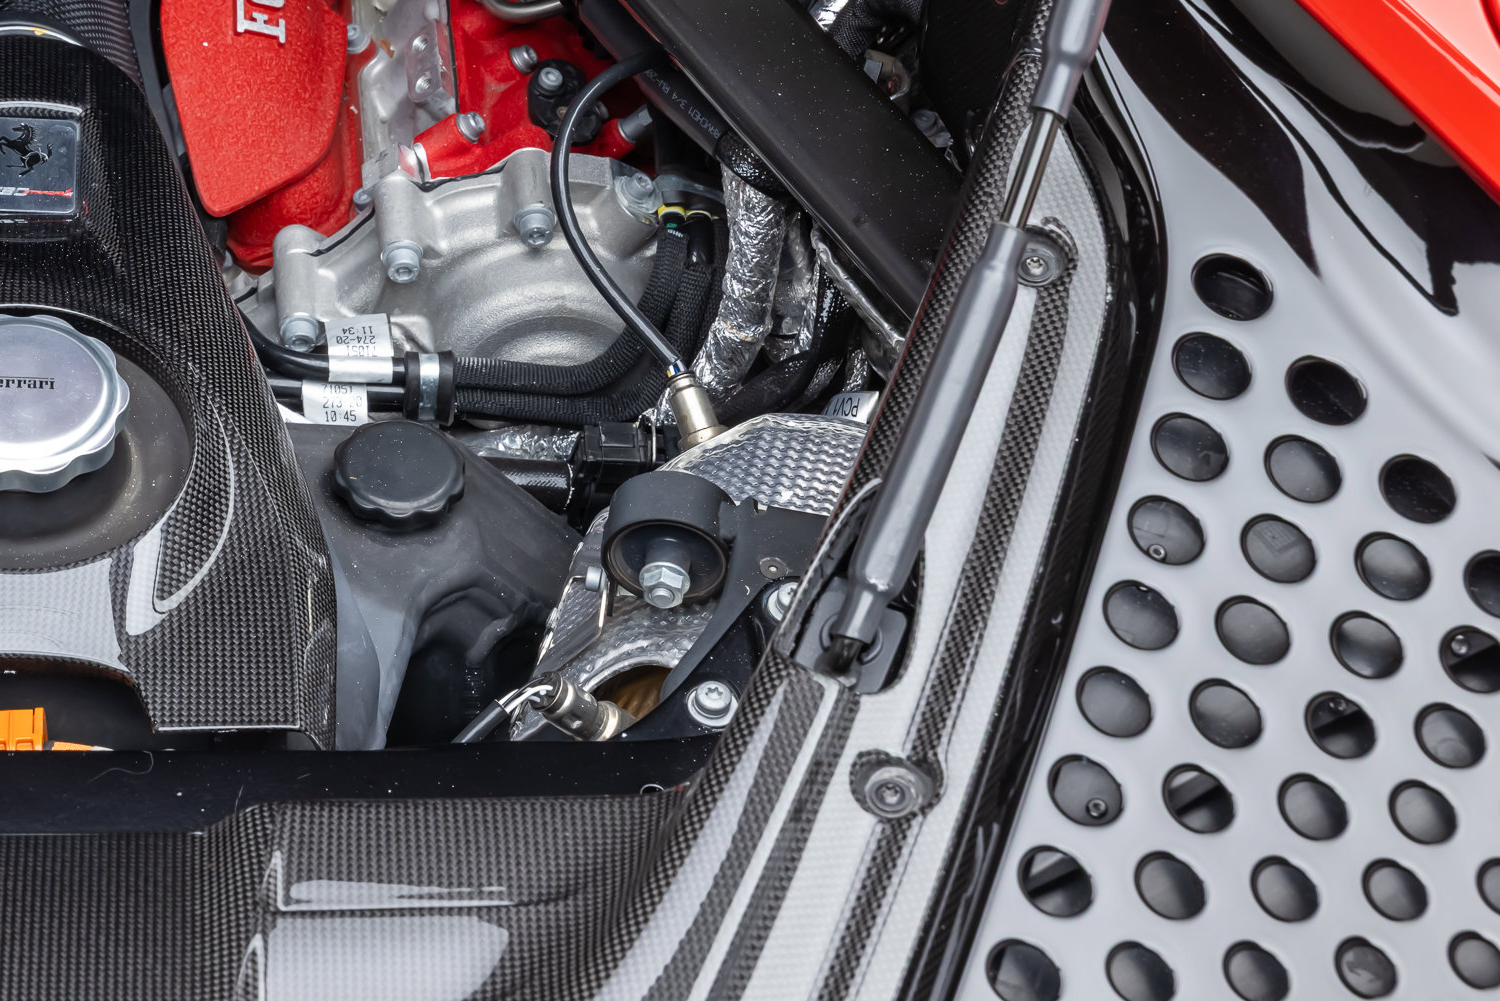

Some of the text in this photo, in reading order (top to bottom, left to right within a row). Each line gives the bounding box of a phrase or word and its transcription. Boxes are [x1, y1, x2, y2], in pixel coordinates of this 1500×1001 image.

[335, 335, 376, 344] 274-20
[322, 395, 363, 409] 2730
[833, 397, 861, 418] PCV1
